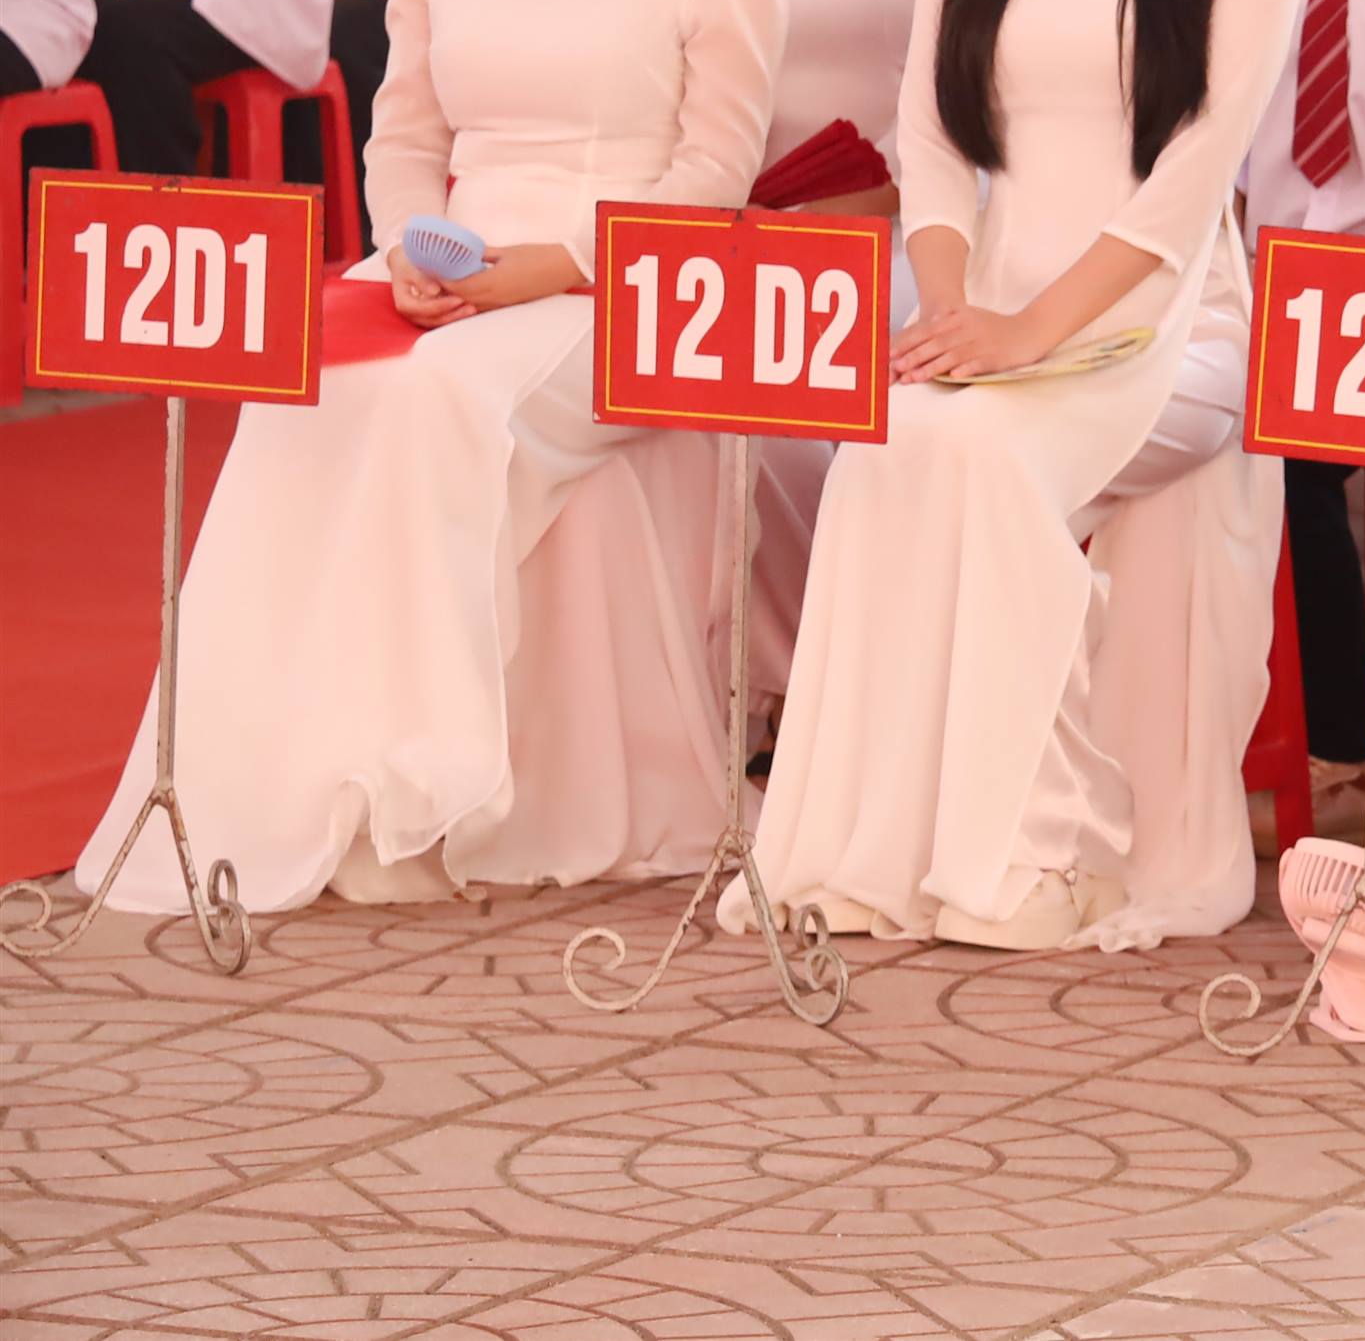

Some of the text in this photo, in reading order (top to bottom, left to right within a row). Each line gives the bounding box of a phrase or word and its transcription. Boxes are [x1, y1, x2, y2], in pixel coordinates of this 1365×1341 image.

[75, 223, 267, 353] 12D1
[626, 256, 859, 391] 12 D2
